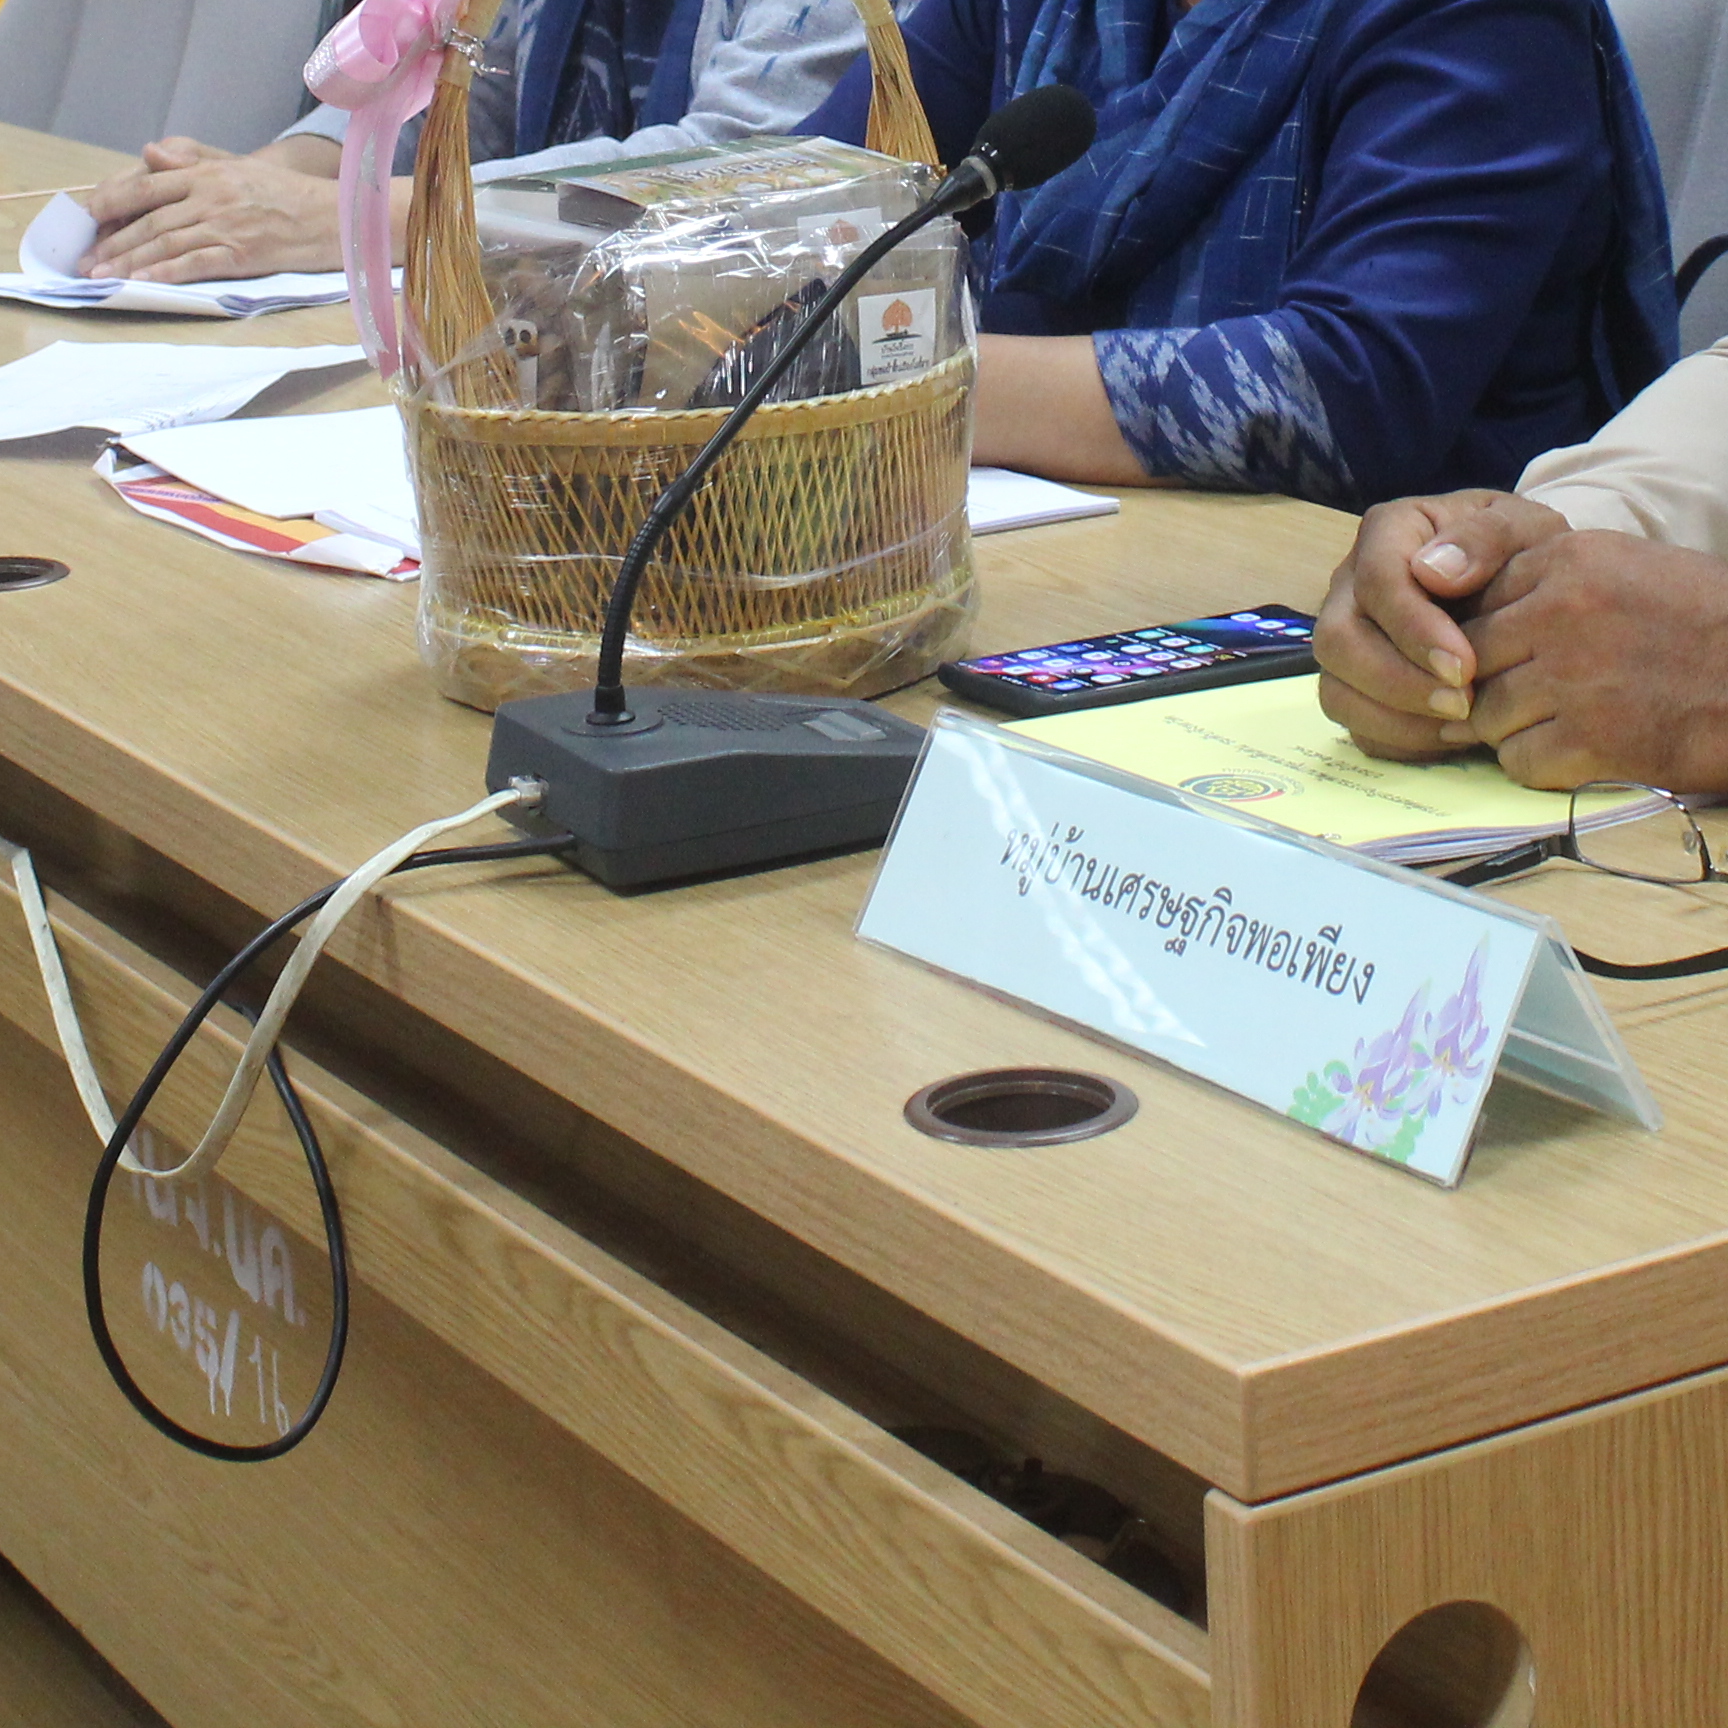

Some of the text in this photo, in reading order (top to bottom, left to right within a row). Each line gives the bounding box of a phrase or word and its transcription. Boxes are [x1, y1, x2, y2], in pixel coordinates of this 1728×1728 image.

[1000, 822, 1375, 1004] หมู่บ้านเศรษฐกิจพอเพียง
